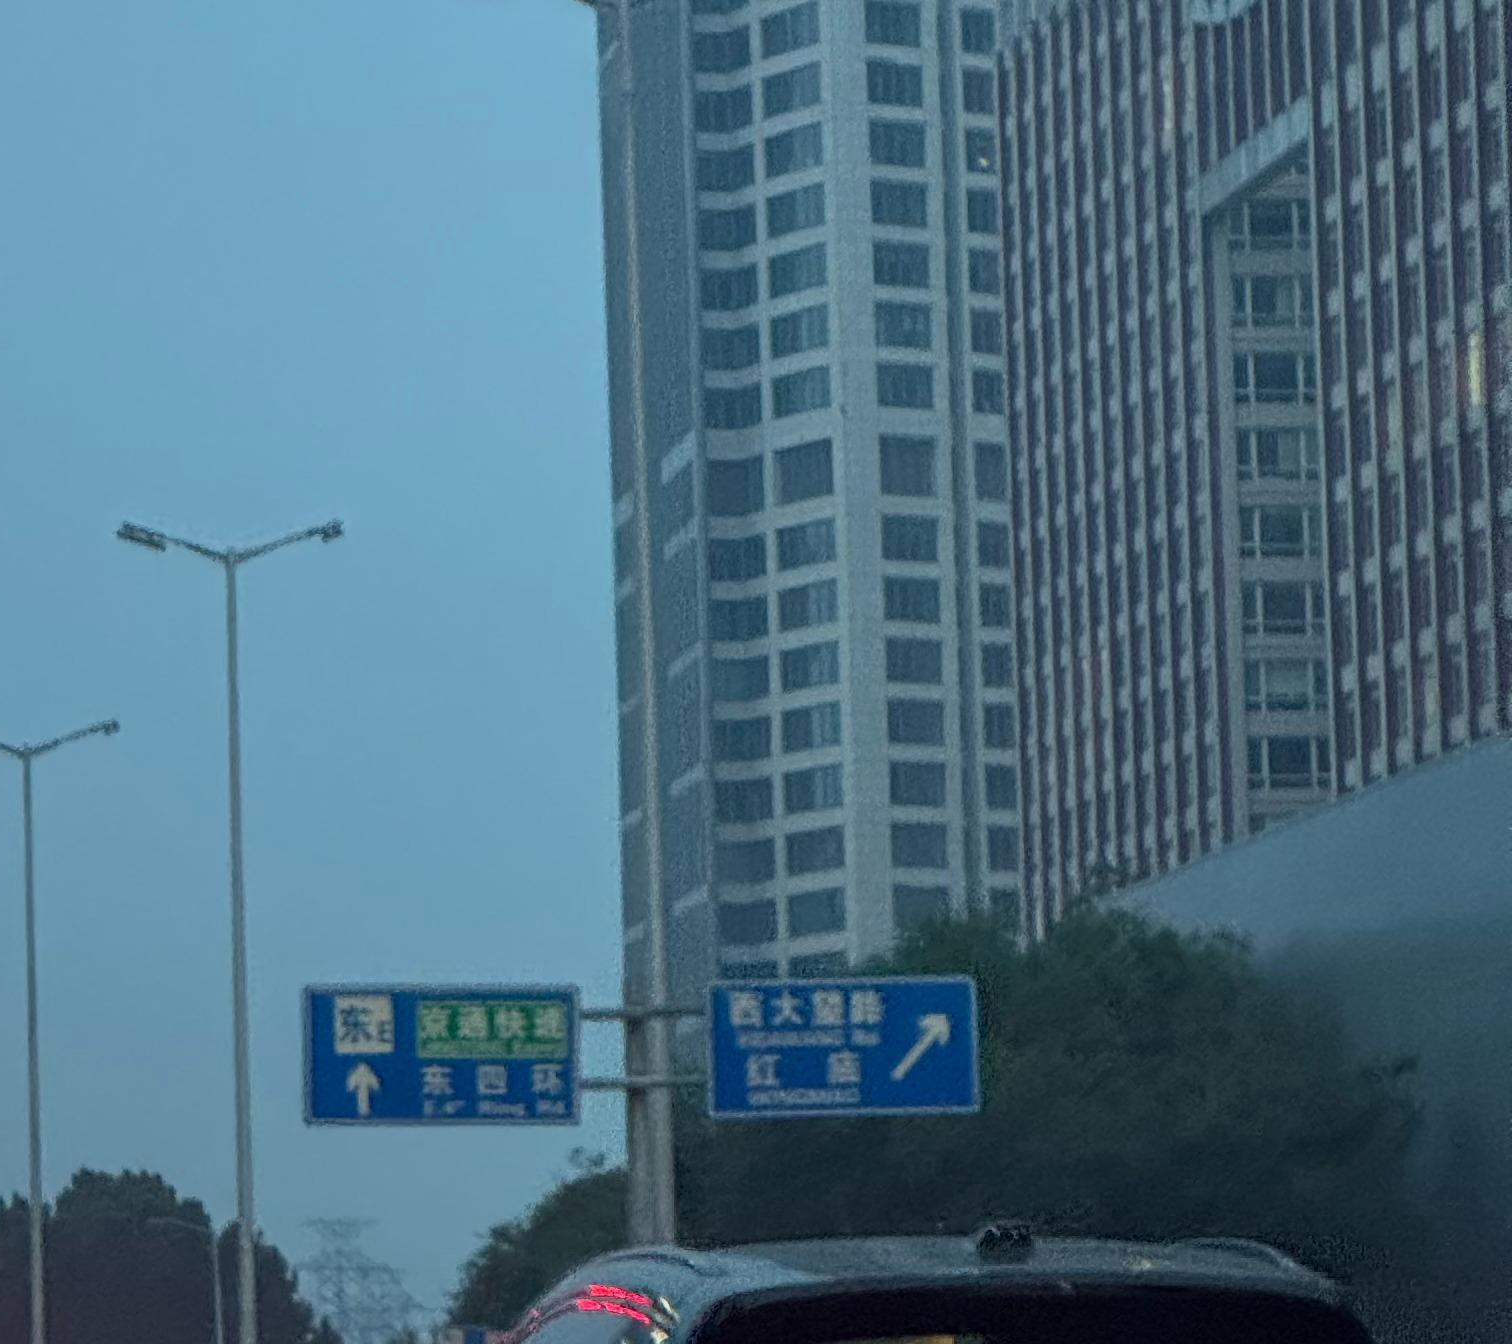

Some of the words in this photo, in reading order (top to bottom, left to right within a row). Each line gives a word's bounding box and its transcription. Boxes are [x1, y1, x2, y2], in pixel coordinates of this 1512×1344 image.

[339, 1006, 373, 1043] 东
[421, 1064, 565, 1096] 东四环
